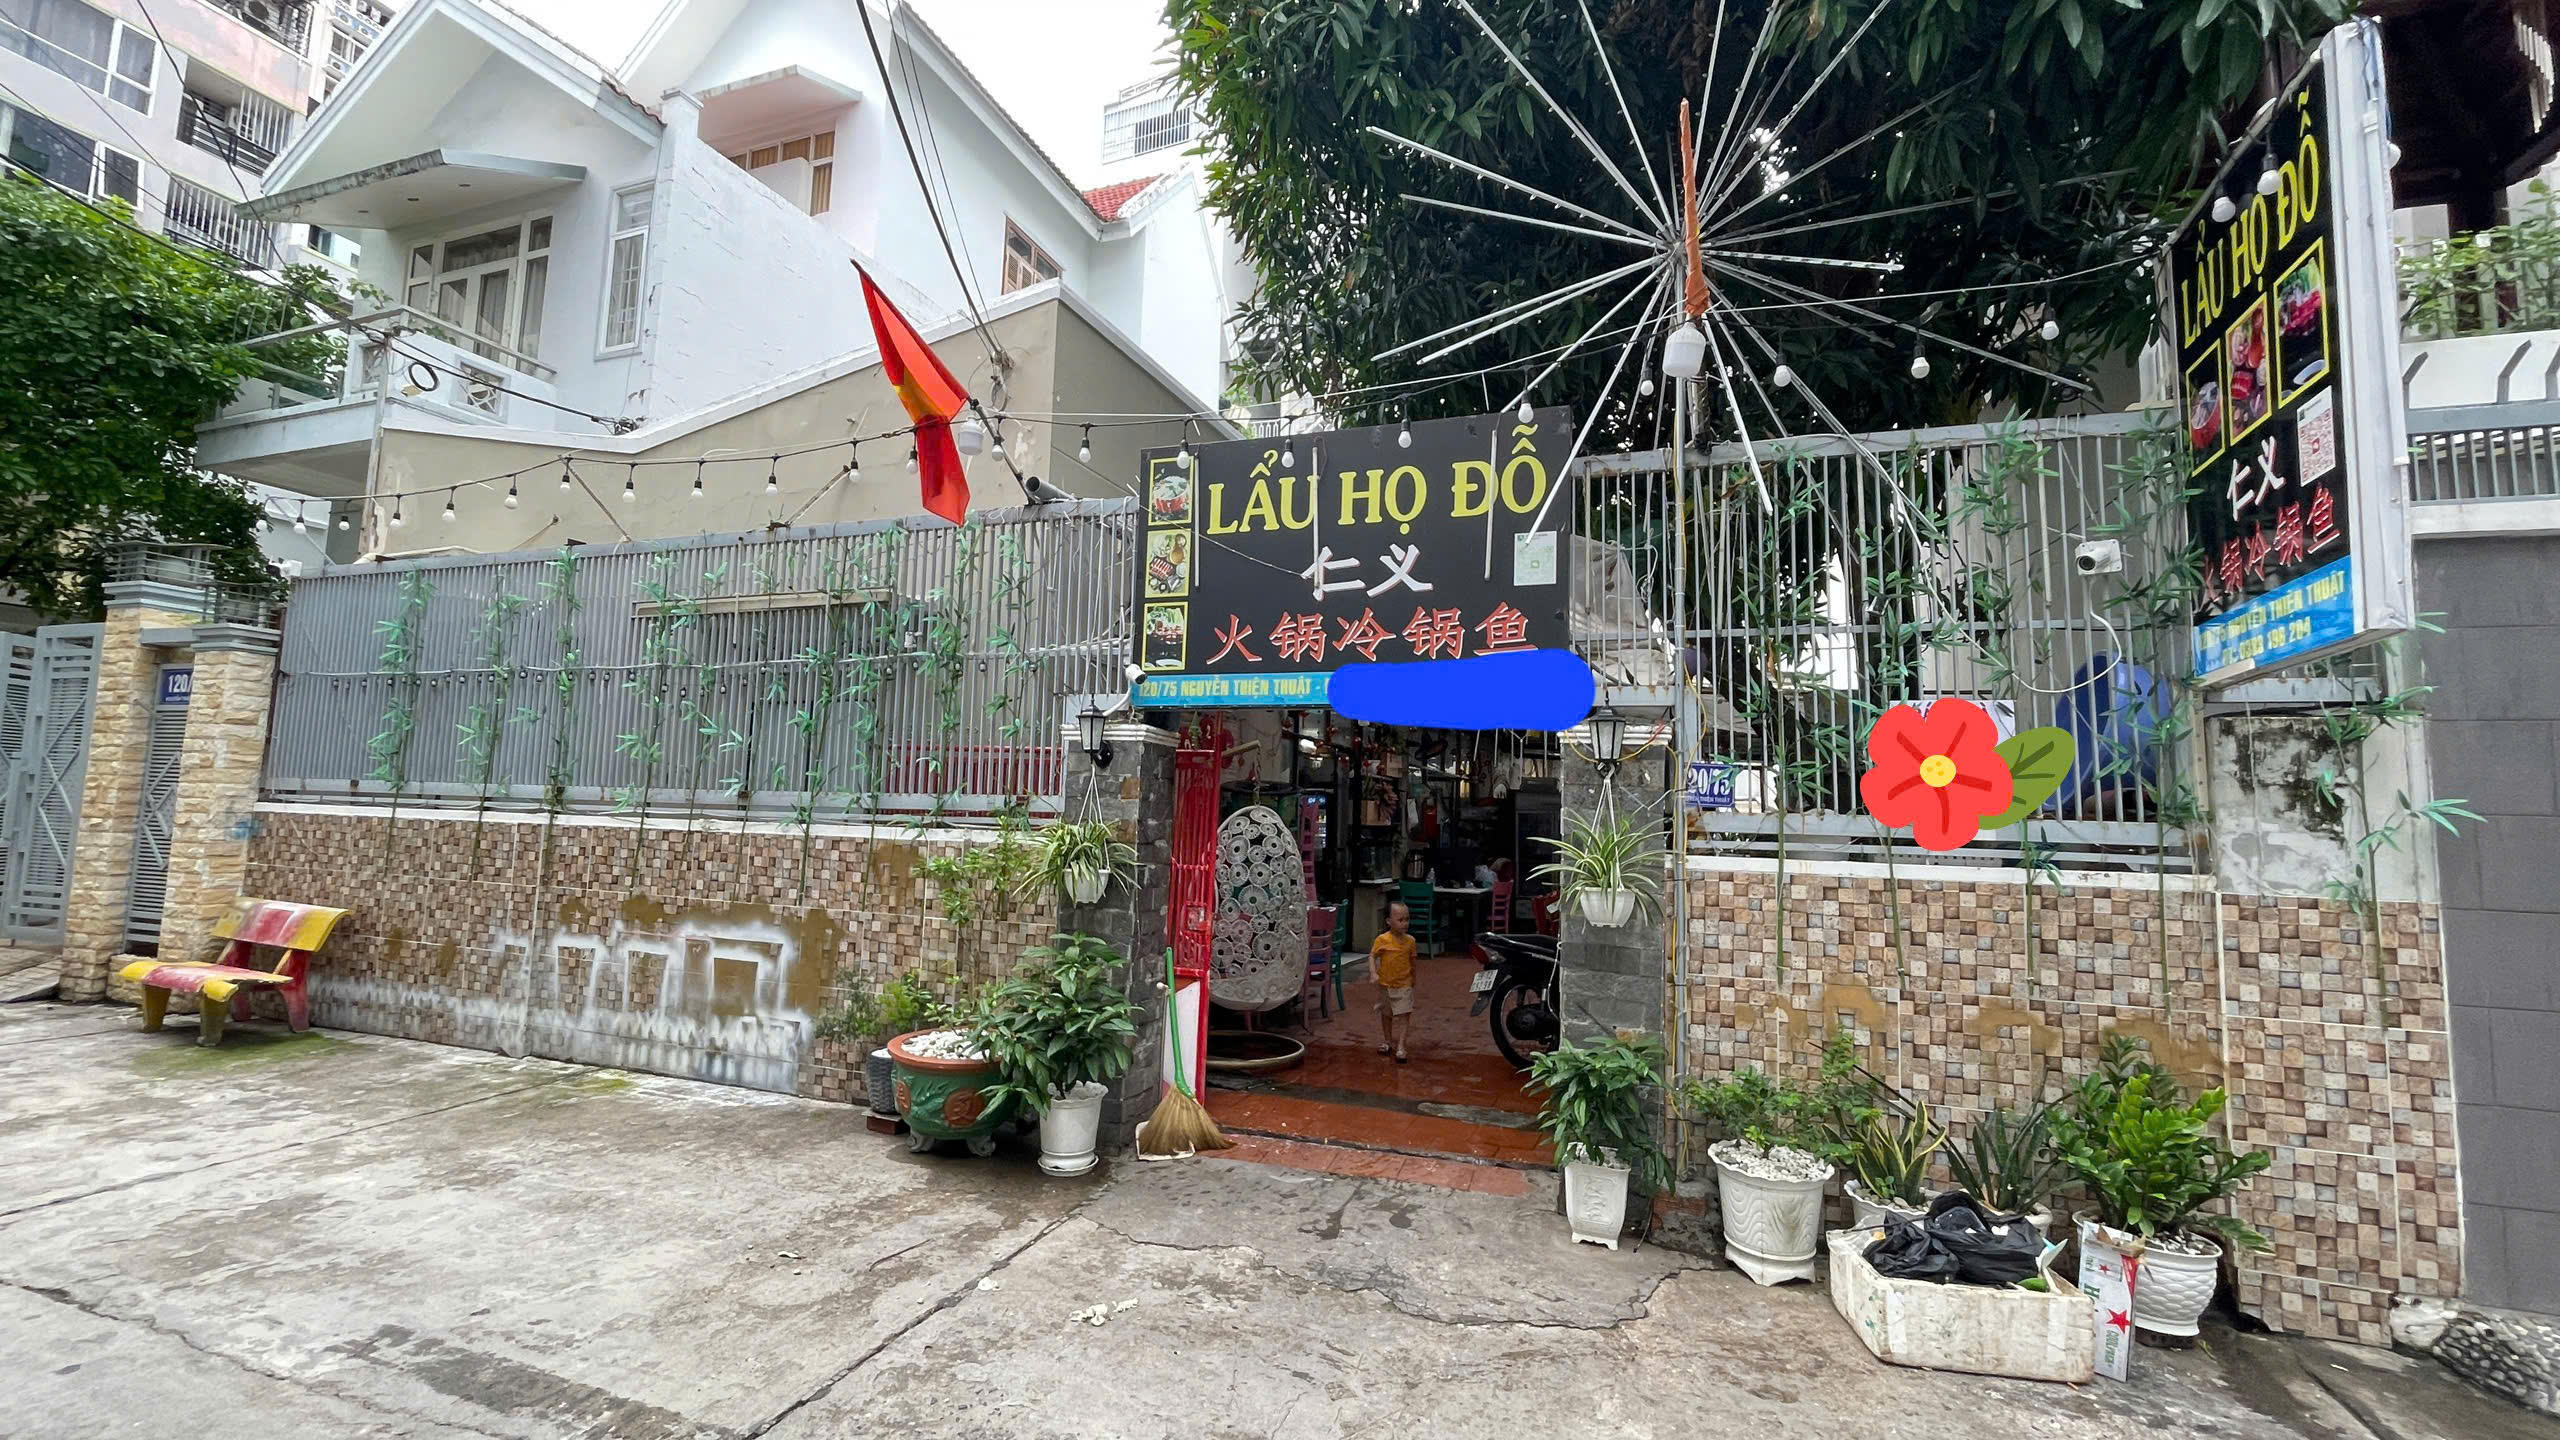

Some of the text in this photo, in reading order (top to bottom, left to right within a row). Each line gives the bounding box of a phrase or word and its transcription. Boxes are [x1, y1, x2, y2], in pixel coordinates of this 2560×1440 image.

[2181, 84, 2320, 349] LẨU HỌ ĐỖ
[1206, 423, 1547, 535] LẨU HỌ ĐỖ
[2226, 435, 2288, 523] 仁义
[1301, 542, 1434, 602] 仁义
[2305, 570, 2346, 606] THUẬT
[1205, 600, 1539, 666] 火锅冷锅鱼
[1180, 677, 1230, 697] NGUYỄN
[1233, 676, 1270, 699] THIỆN
[1272, 676, 1313, 698] THUẬT
[1687, 768, 1731, 796] 20/75
